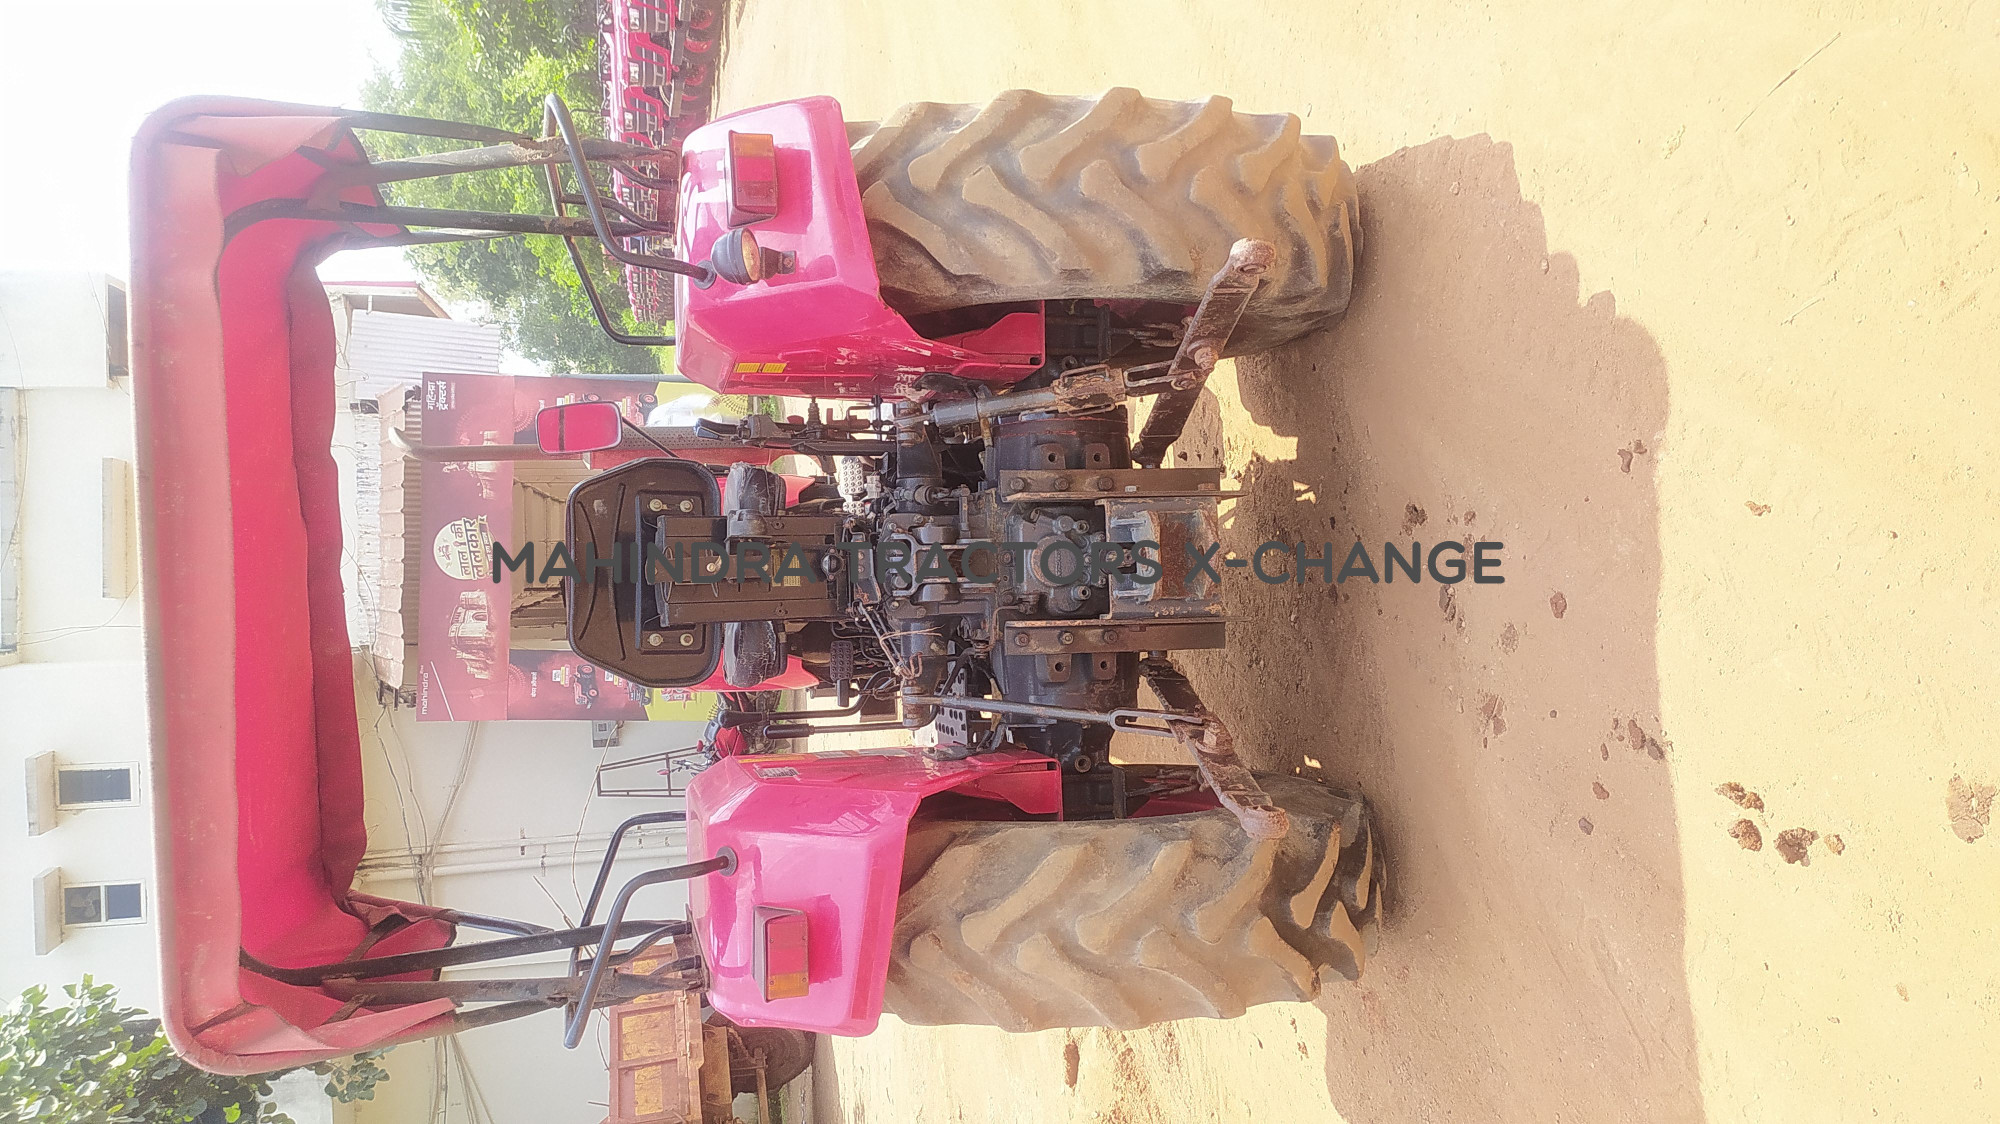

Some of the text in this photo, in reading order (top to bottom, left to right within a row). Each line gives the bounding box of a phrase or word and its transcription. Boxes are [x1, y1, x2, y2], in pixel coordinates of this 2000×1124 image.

[450, 523, 470, 576] लाल की
[463, 519, 484, 579] ललकार
